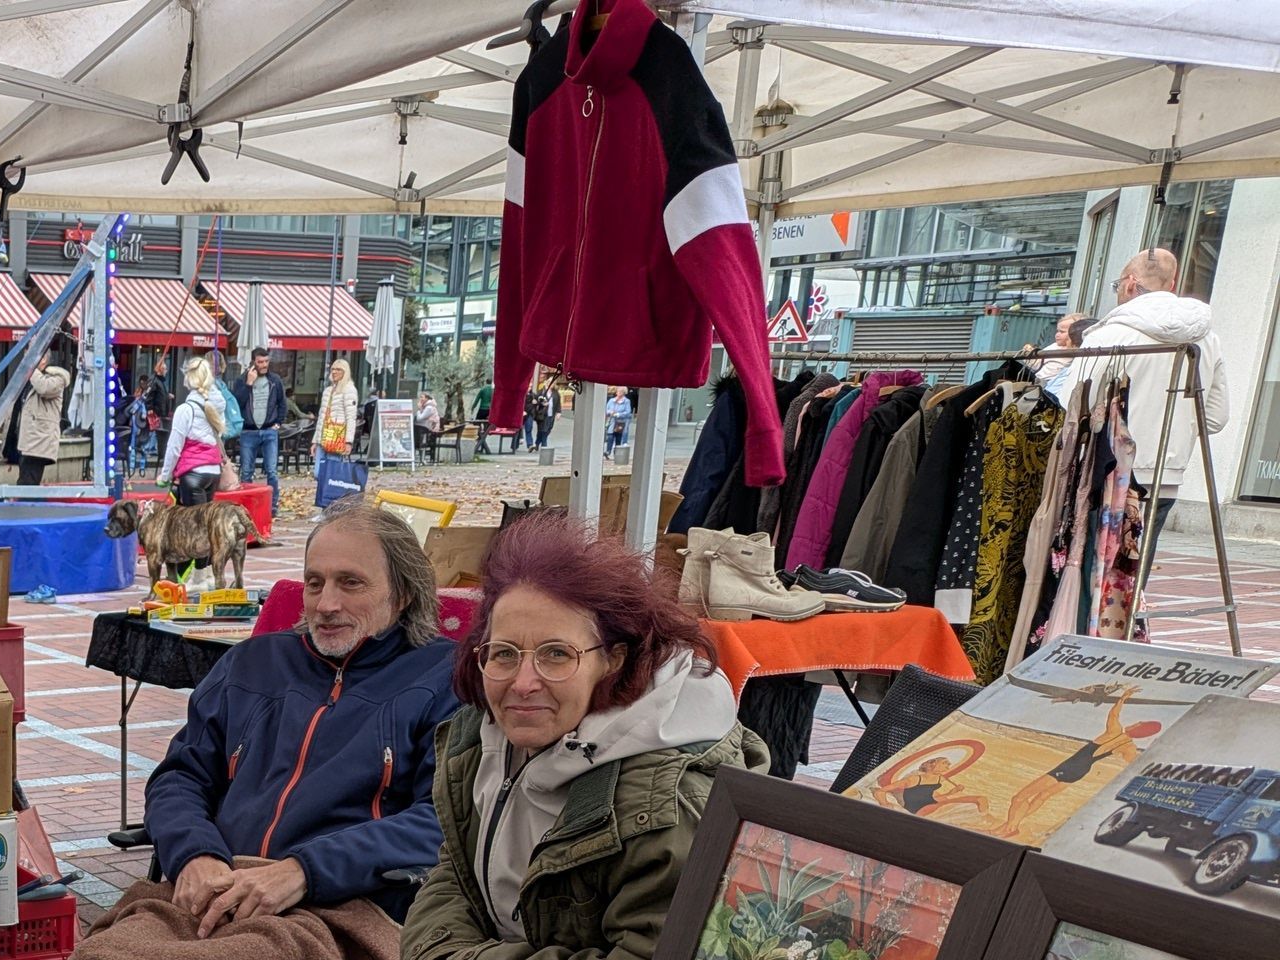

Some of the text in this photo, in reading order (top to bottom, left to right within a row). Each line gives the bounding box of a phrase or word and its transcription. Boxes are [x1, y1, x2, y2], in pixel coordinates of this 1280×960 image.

[1043, 643, 1258, 690] Fliegt in die Bäder!
